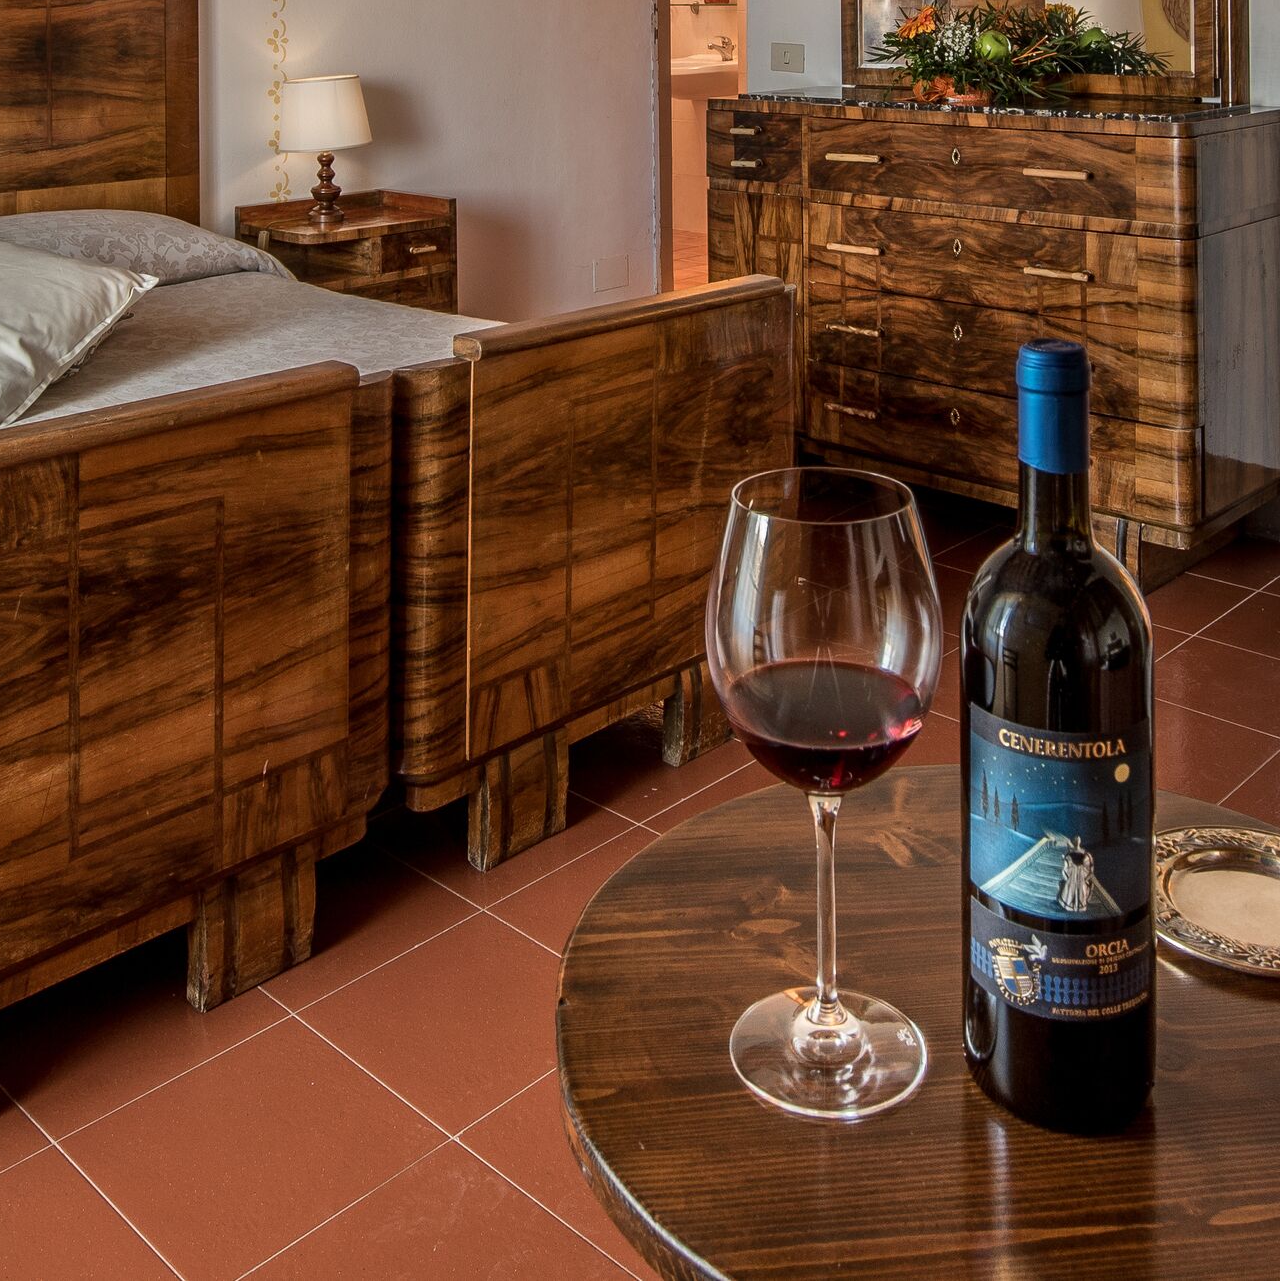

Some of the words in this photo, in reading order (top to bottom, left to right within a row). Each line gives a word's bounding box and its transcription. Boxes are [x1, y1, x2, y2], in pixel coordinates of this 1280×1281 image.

[998, 728, 1126, 759] CENERENTOLA
[1085, 939, 1129, 958] ORCIA
[1099, 963, 1119, 975] 2013
